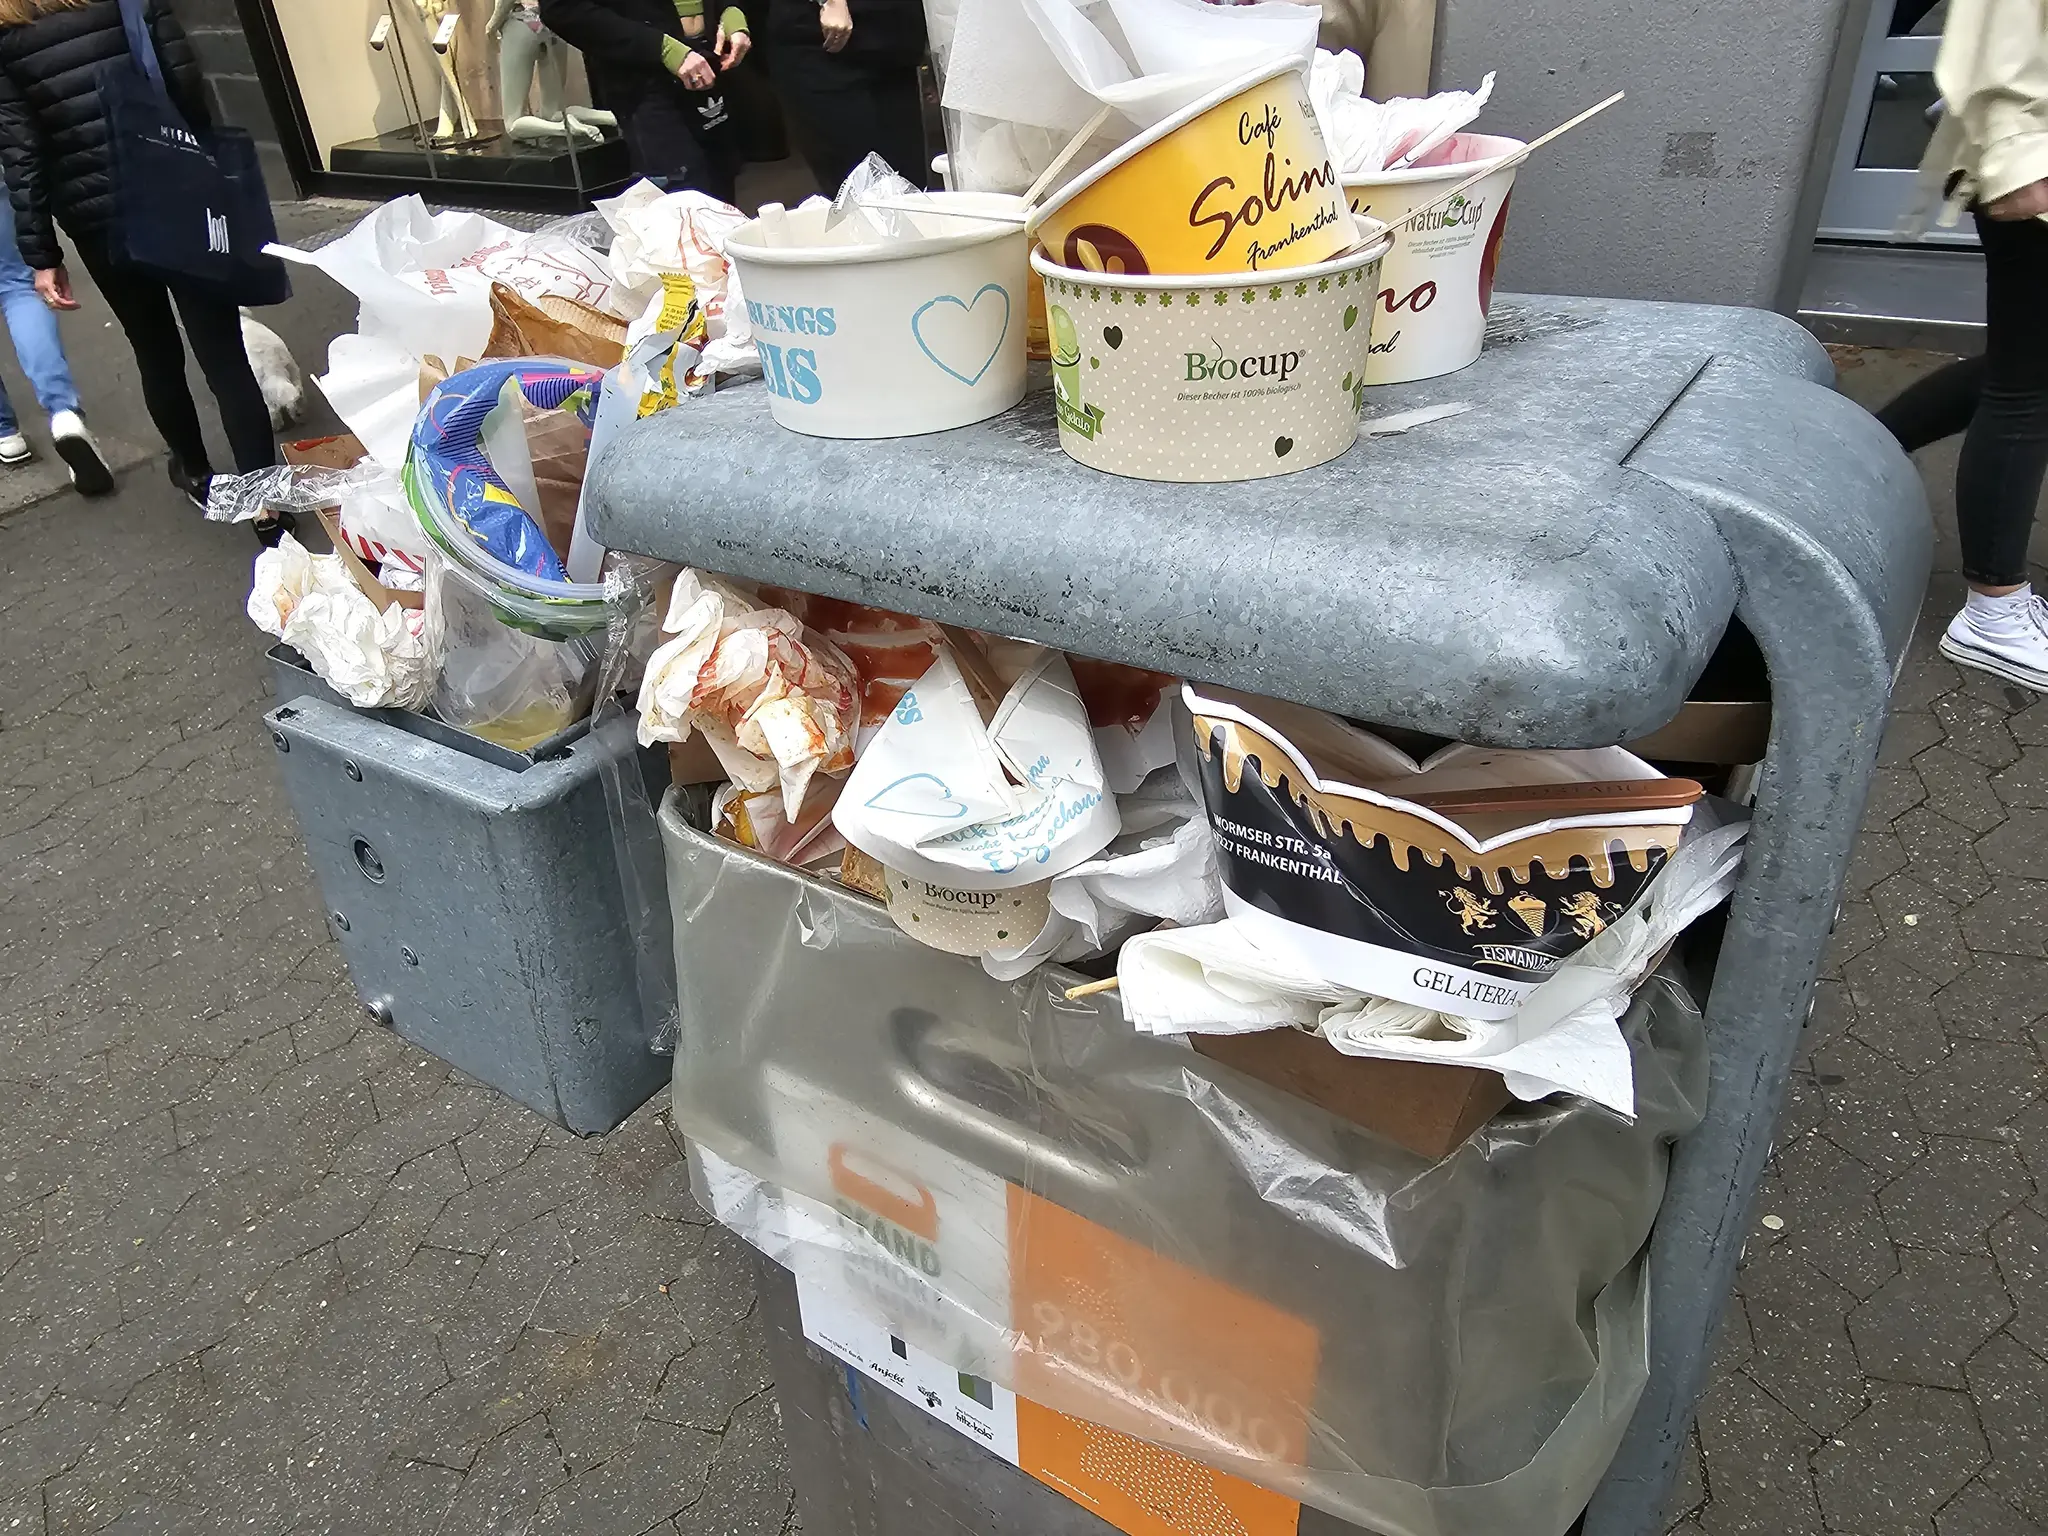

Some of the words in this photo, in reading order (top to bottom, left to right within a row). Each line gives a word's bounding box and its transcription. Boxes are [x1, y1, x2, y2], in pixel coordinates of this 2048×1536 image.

[1238, 103, 1281, 149] Café
[1189, 152, 1335, 260] Solino
[1246, 201, 1339, 271] Frankenthal
[755, 339, 823, 404] EIS
[1177, 392, 1201, 401] Dieser
[1203, 391, 1230, 401] Becher
[1230, 391, 1241, 400] ist
[1243, 388, 1265, 398] 100%
[1266, 383, 1302, 396] biologisch
[1213, 812, 1272, 847] WORMSER
[1275, 834, 1309, 856] STR.
[1312, 843, 1332, 861] 5a
[1236, 844, 1344, 885] FRANKENTHAL
[1413, 967, 1518, 1006] GELATERIA
